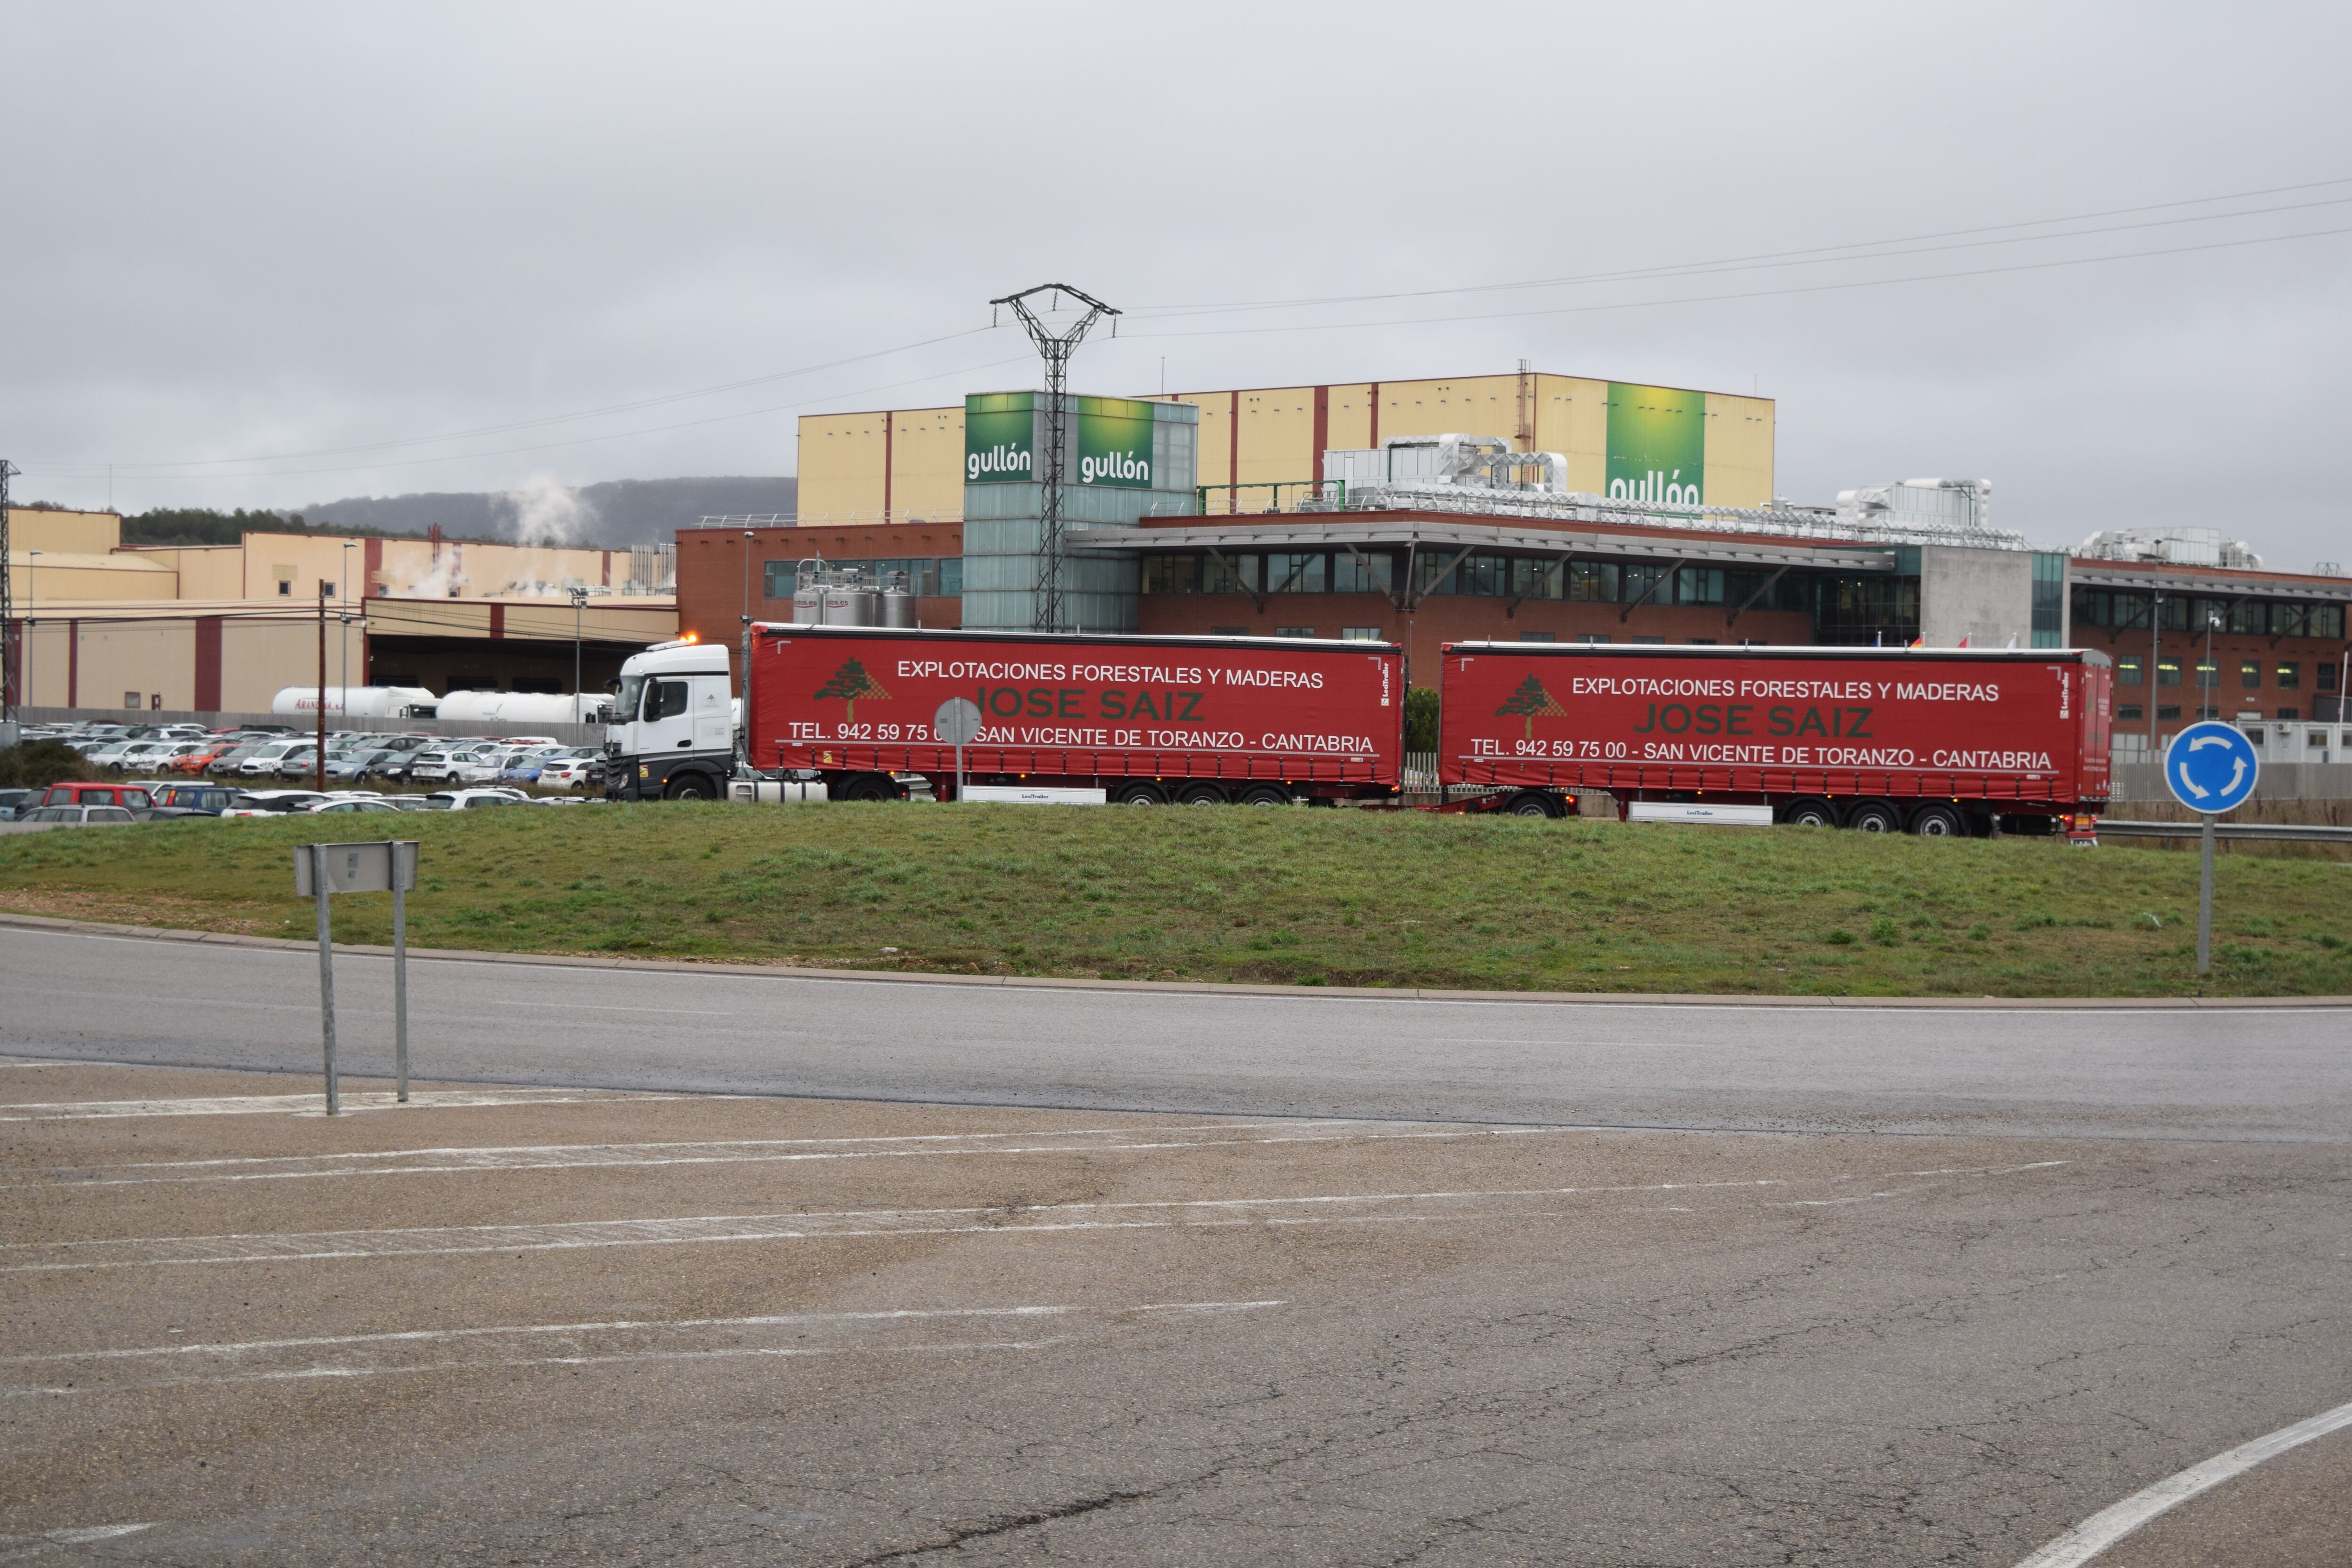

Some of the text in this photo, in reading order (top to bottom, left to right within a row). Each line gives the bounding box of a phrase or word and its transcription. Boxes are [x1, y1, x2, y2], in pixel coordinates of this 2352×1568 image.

[968, 443, 1031, 479] gullón
[1082, 451, 1148, 483] gullón
[898, 661, 1323, 689] EXPLOTACIONES FORESTALES Y MADERAS
[1573, 677, 1999, 701] EXPLOTACIONES FORESTALES Y MADERAS
[1100, 690, 1204, 721] SAIZ
[1634, 704, 1873, 738] JOSE SAIZ
[788, 722, 831, 739] TEL.
[838, 723, 871, 740] 942
[877, 724, 900, 740] 59
[906, 724, 928, 740] 75
[974, 726, 1015, 743] SAN
[1021, 727, 1107, 745] VICENTE
[1115, 730, 1142, 746] DE
[1147, 730, 1244, 748] TORANZO
[1262, 733, 1374, 753] CANTABRIA
[1470, 739, 1509, 755] TEL.
[1516, 740, 1547, 756] 942
[1552, 740, 1573, 756] 59
[1579, 741, 1600, 757] 75
[1605, 741, 1627, 758] 00
[1644, 742, 1683, 760] SAN
[1689, 744, 1775, 763] VICENTE
[1782, 747, 1809, 764] DE
[1815, 748, 1914, 766] TORANZO
[1932, 749, 2051, 770] CANTABRIA
